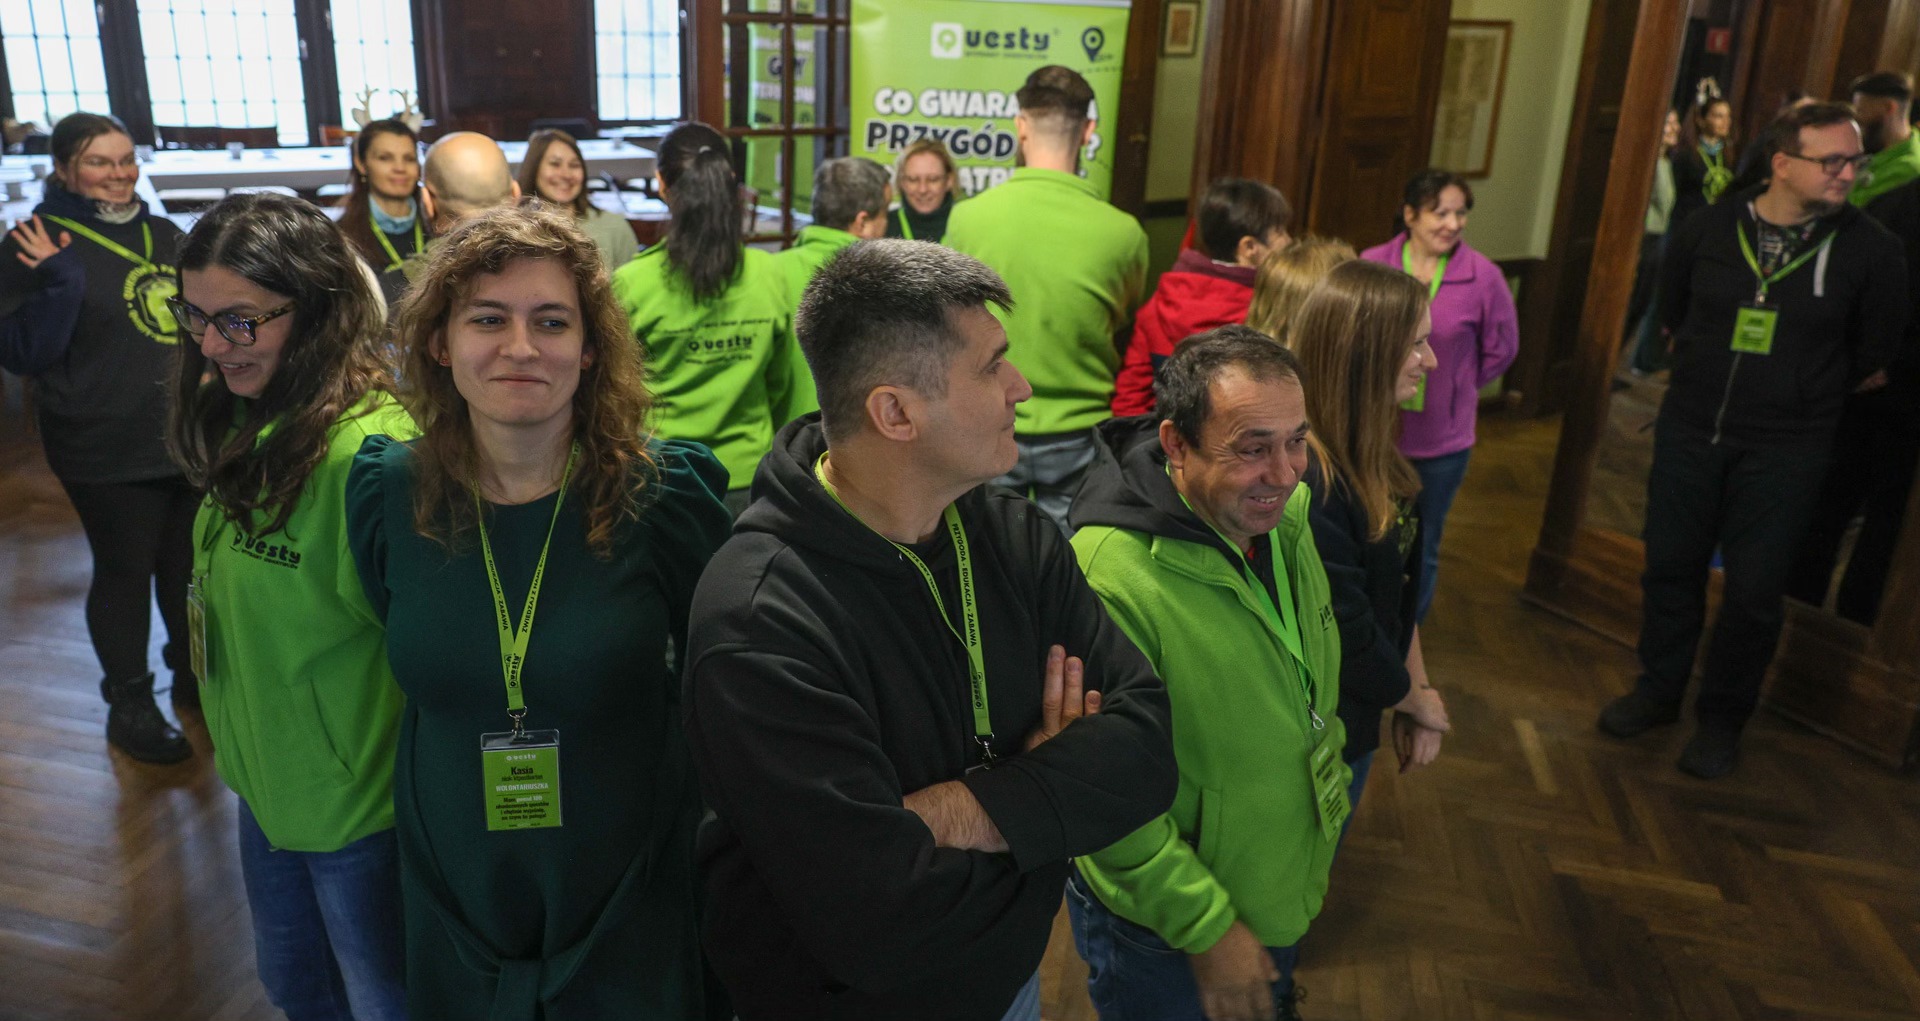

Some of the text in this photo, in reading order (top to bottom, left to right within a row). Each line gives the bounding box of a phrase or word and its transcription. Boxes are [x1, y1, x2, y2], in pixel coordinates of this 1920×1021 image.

[873, 87, 914, 116] CO
[499, 600, 509, 631] ZABAWA
[522, 596, 535, 633] ZWIEDZAJ
[961, 567, 972, 608] EDUKACJA
[967, 612, 977, 648] ZABAWA
[510, 766, 534, 776] Kasia
[495, 782, 549, 792] WOLONTARIUSZKA
